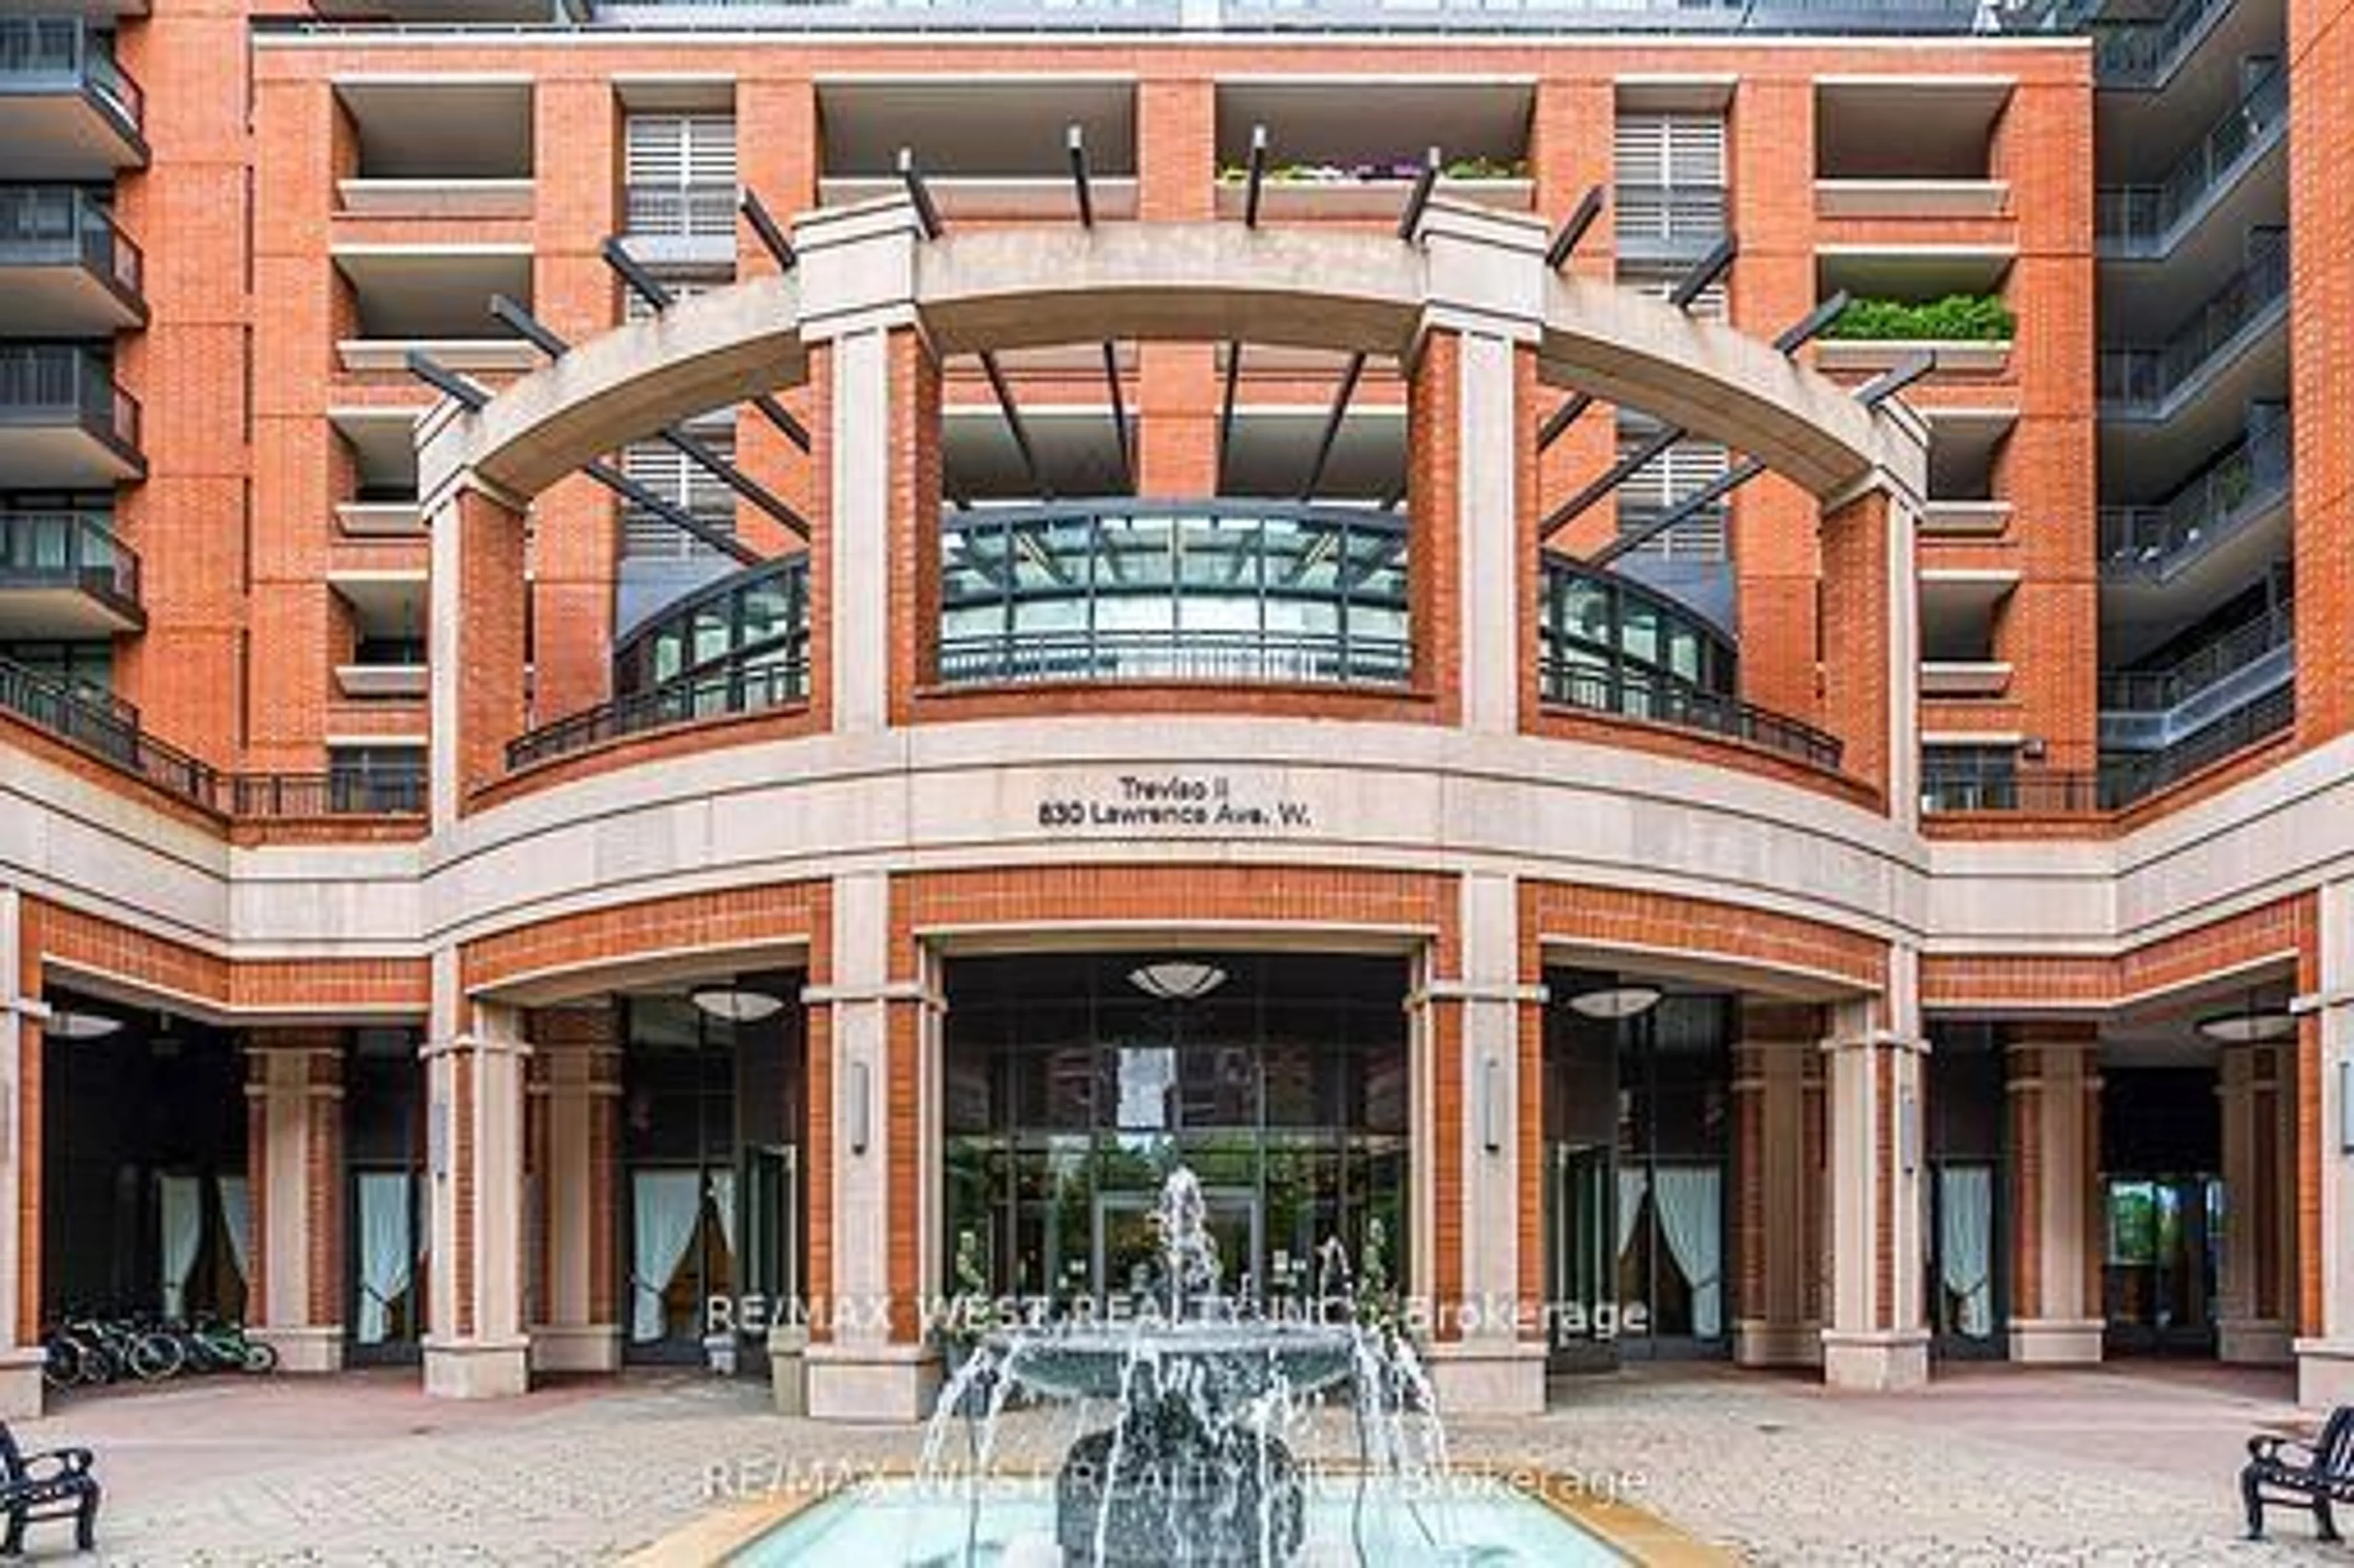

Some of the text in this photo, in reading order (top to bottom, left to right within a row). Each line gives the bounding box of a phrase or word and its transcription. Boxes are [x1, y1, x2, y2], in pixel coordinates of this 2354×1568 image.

[1120, 777, 1206, 800] Treviso
[1038, 802, 1312, 826] 830 Lawrence Ave. W.
